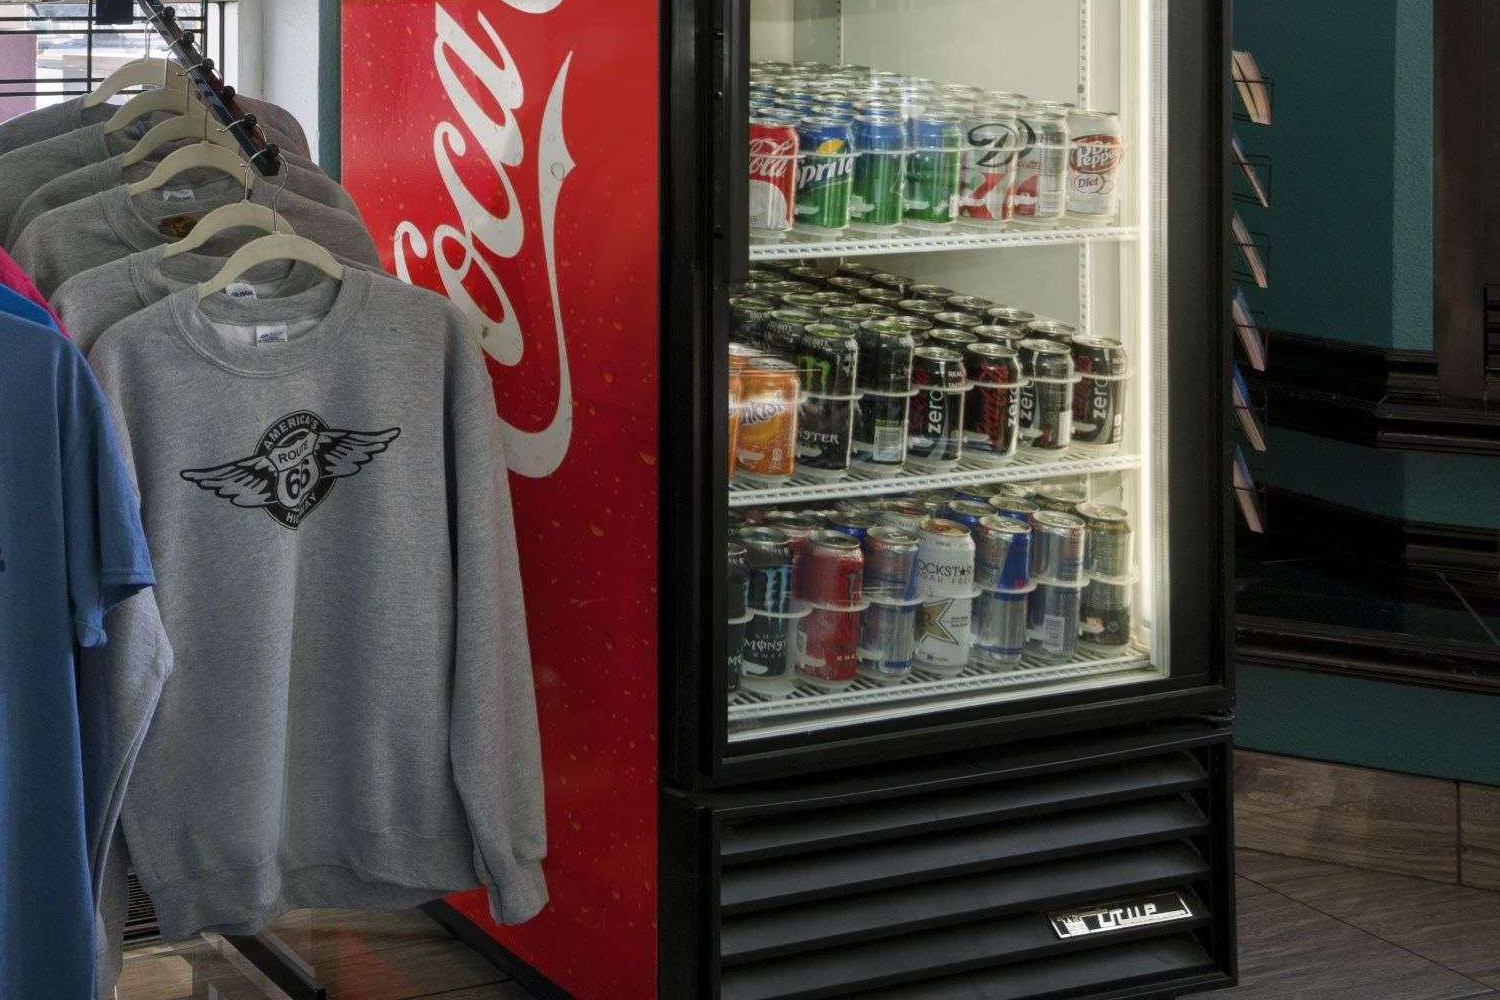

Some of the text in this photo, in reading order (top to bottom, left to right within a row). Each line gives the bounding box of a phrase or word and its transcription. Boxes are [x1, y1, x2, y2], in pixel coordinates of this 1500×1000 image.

[797, 149, 853, 189] prite
[1076, 145, 1118, 170] Peppe
[1077, 177, 1099, 189] Diet
[928, 389, 943, 434] zero
[264, 414, 319, 449] AMERICA'S
[278, 440, 309, 465] ROUTE
